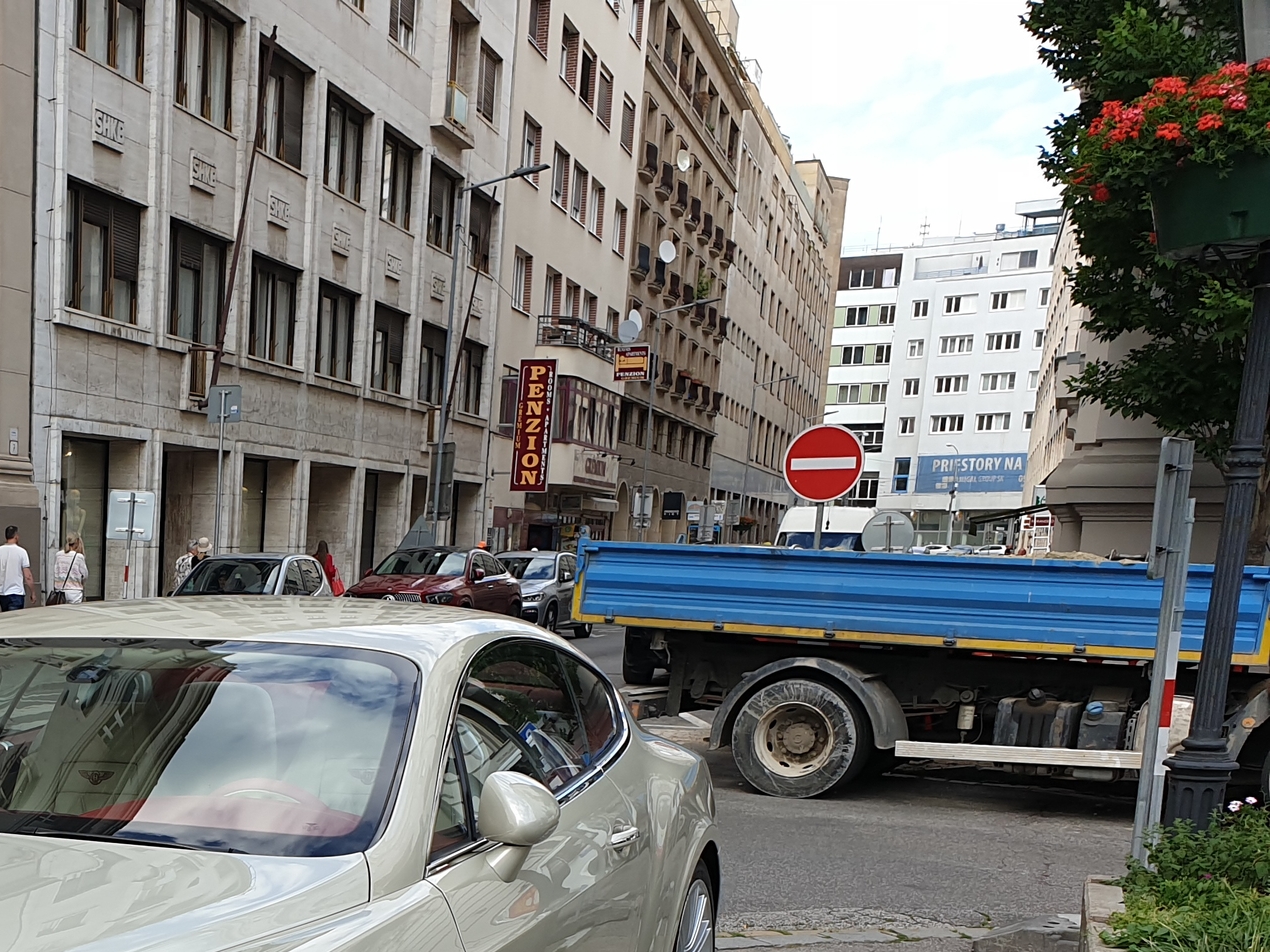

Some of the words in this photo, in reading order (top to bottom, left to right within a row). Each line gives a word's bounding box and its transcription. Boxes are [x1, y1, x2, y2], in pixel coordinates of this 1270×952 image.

[520, 366, 546, 485] PENZION
[539, 414, 549, 481] APARTMENTS
[1004, 457, 1022, 471] NA
